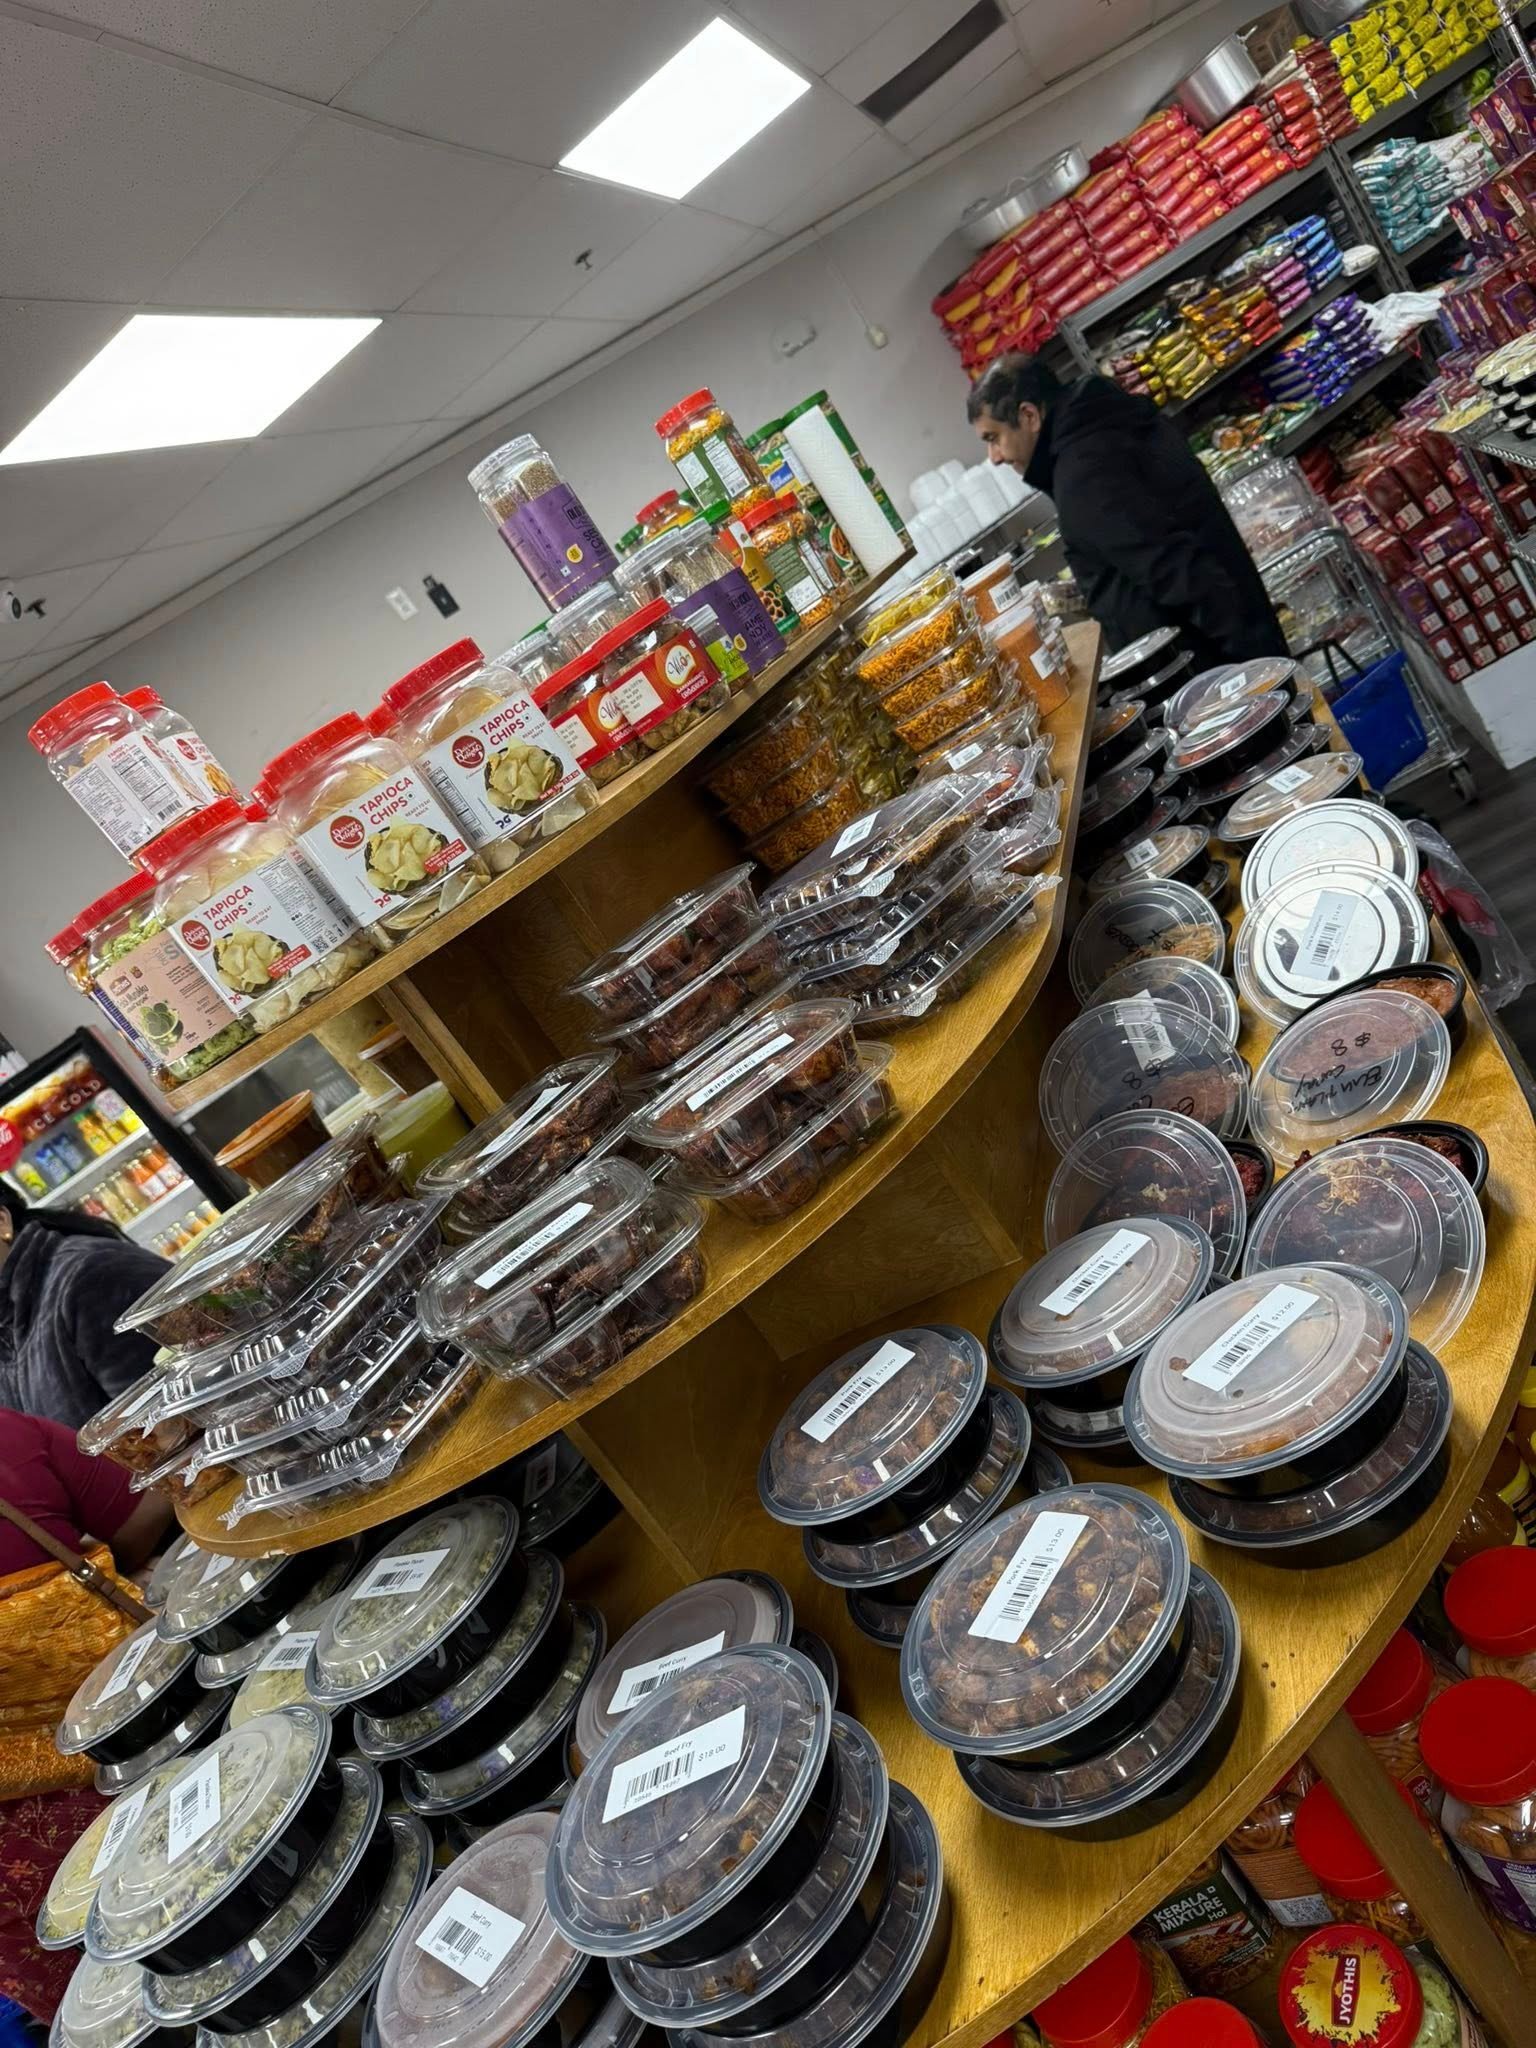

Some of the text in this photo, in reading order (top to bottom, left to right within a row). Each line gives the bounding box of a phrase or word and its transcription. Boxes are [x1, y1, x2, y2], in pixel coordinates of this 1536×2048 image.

[479, 699, 530, 735] TAPIOCA
[489, 718, 526, 746] CHIPS
[359, 776, 414, 814] TAPIOCA
[369, 797, 408, 825] CHIPS
[203, 885, 254, 921] TAPIOCA
[213, 905, 248, 931] CHIPS
[26, 1112, 55, 1141] ICE
[60, 1080, 101, 1112] COLD
[1271, 1301, 1295, 1321] $12.00
[1221, 1313, 1261, 1348] Chicken Curry
[1046, 1528, 1065, 1553] $13.00
[1006, 1558, 1027, 1585] Pork Fry
[657, 1655, 687, 1671] Beef Curry
[664, 1740, 693, 1758] Beef Fry
[697, 1744, 726, 1762] $18.00
[470, 1910, 481, 1921] Beef
[1153, 1892, 1209, 1922] KERALA
[1160, 1896, 1223, 1933] MIXTURE
[1207, 1907, 1228, 1921] Hot
[474, 1946, 493, 1962] $15.00
[1339, 1957, 1357, 2024] JYOTHIS
